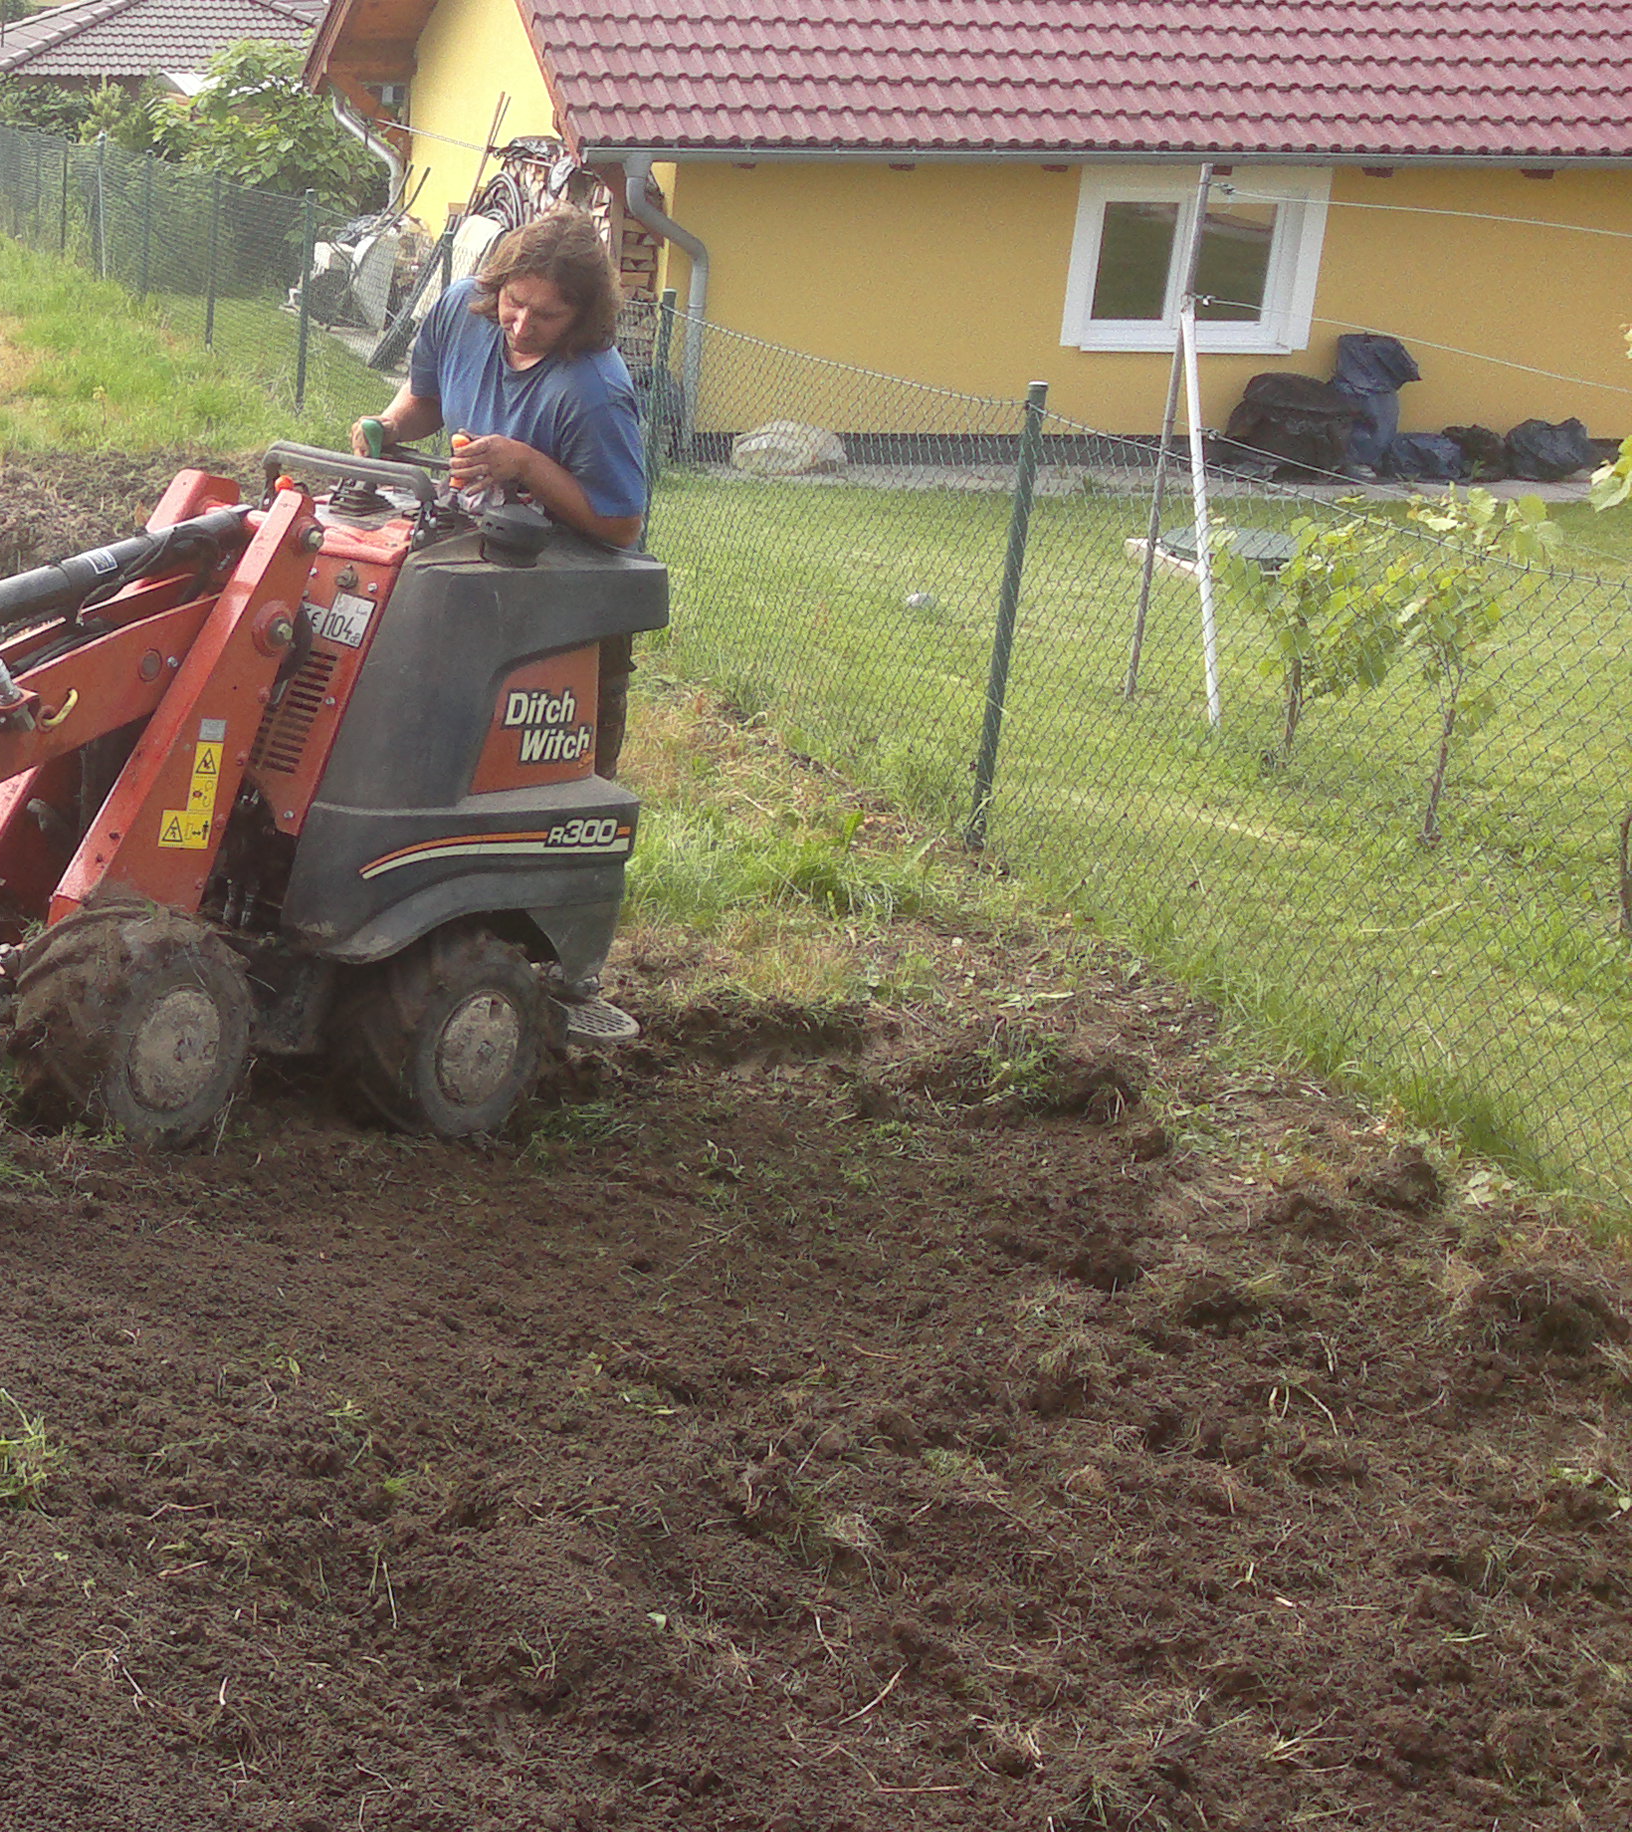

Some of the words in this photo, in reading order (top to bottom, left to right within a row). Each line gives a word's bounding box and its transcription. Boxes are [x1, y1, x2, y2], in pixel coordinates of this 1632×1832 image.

[326, 612, 355, 640] 104
[504, 690, 576, 726] Ditch
[520, 726, 590, 762] Witch
[547, 818, 618, 845] R300
